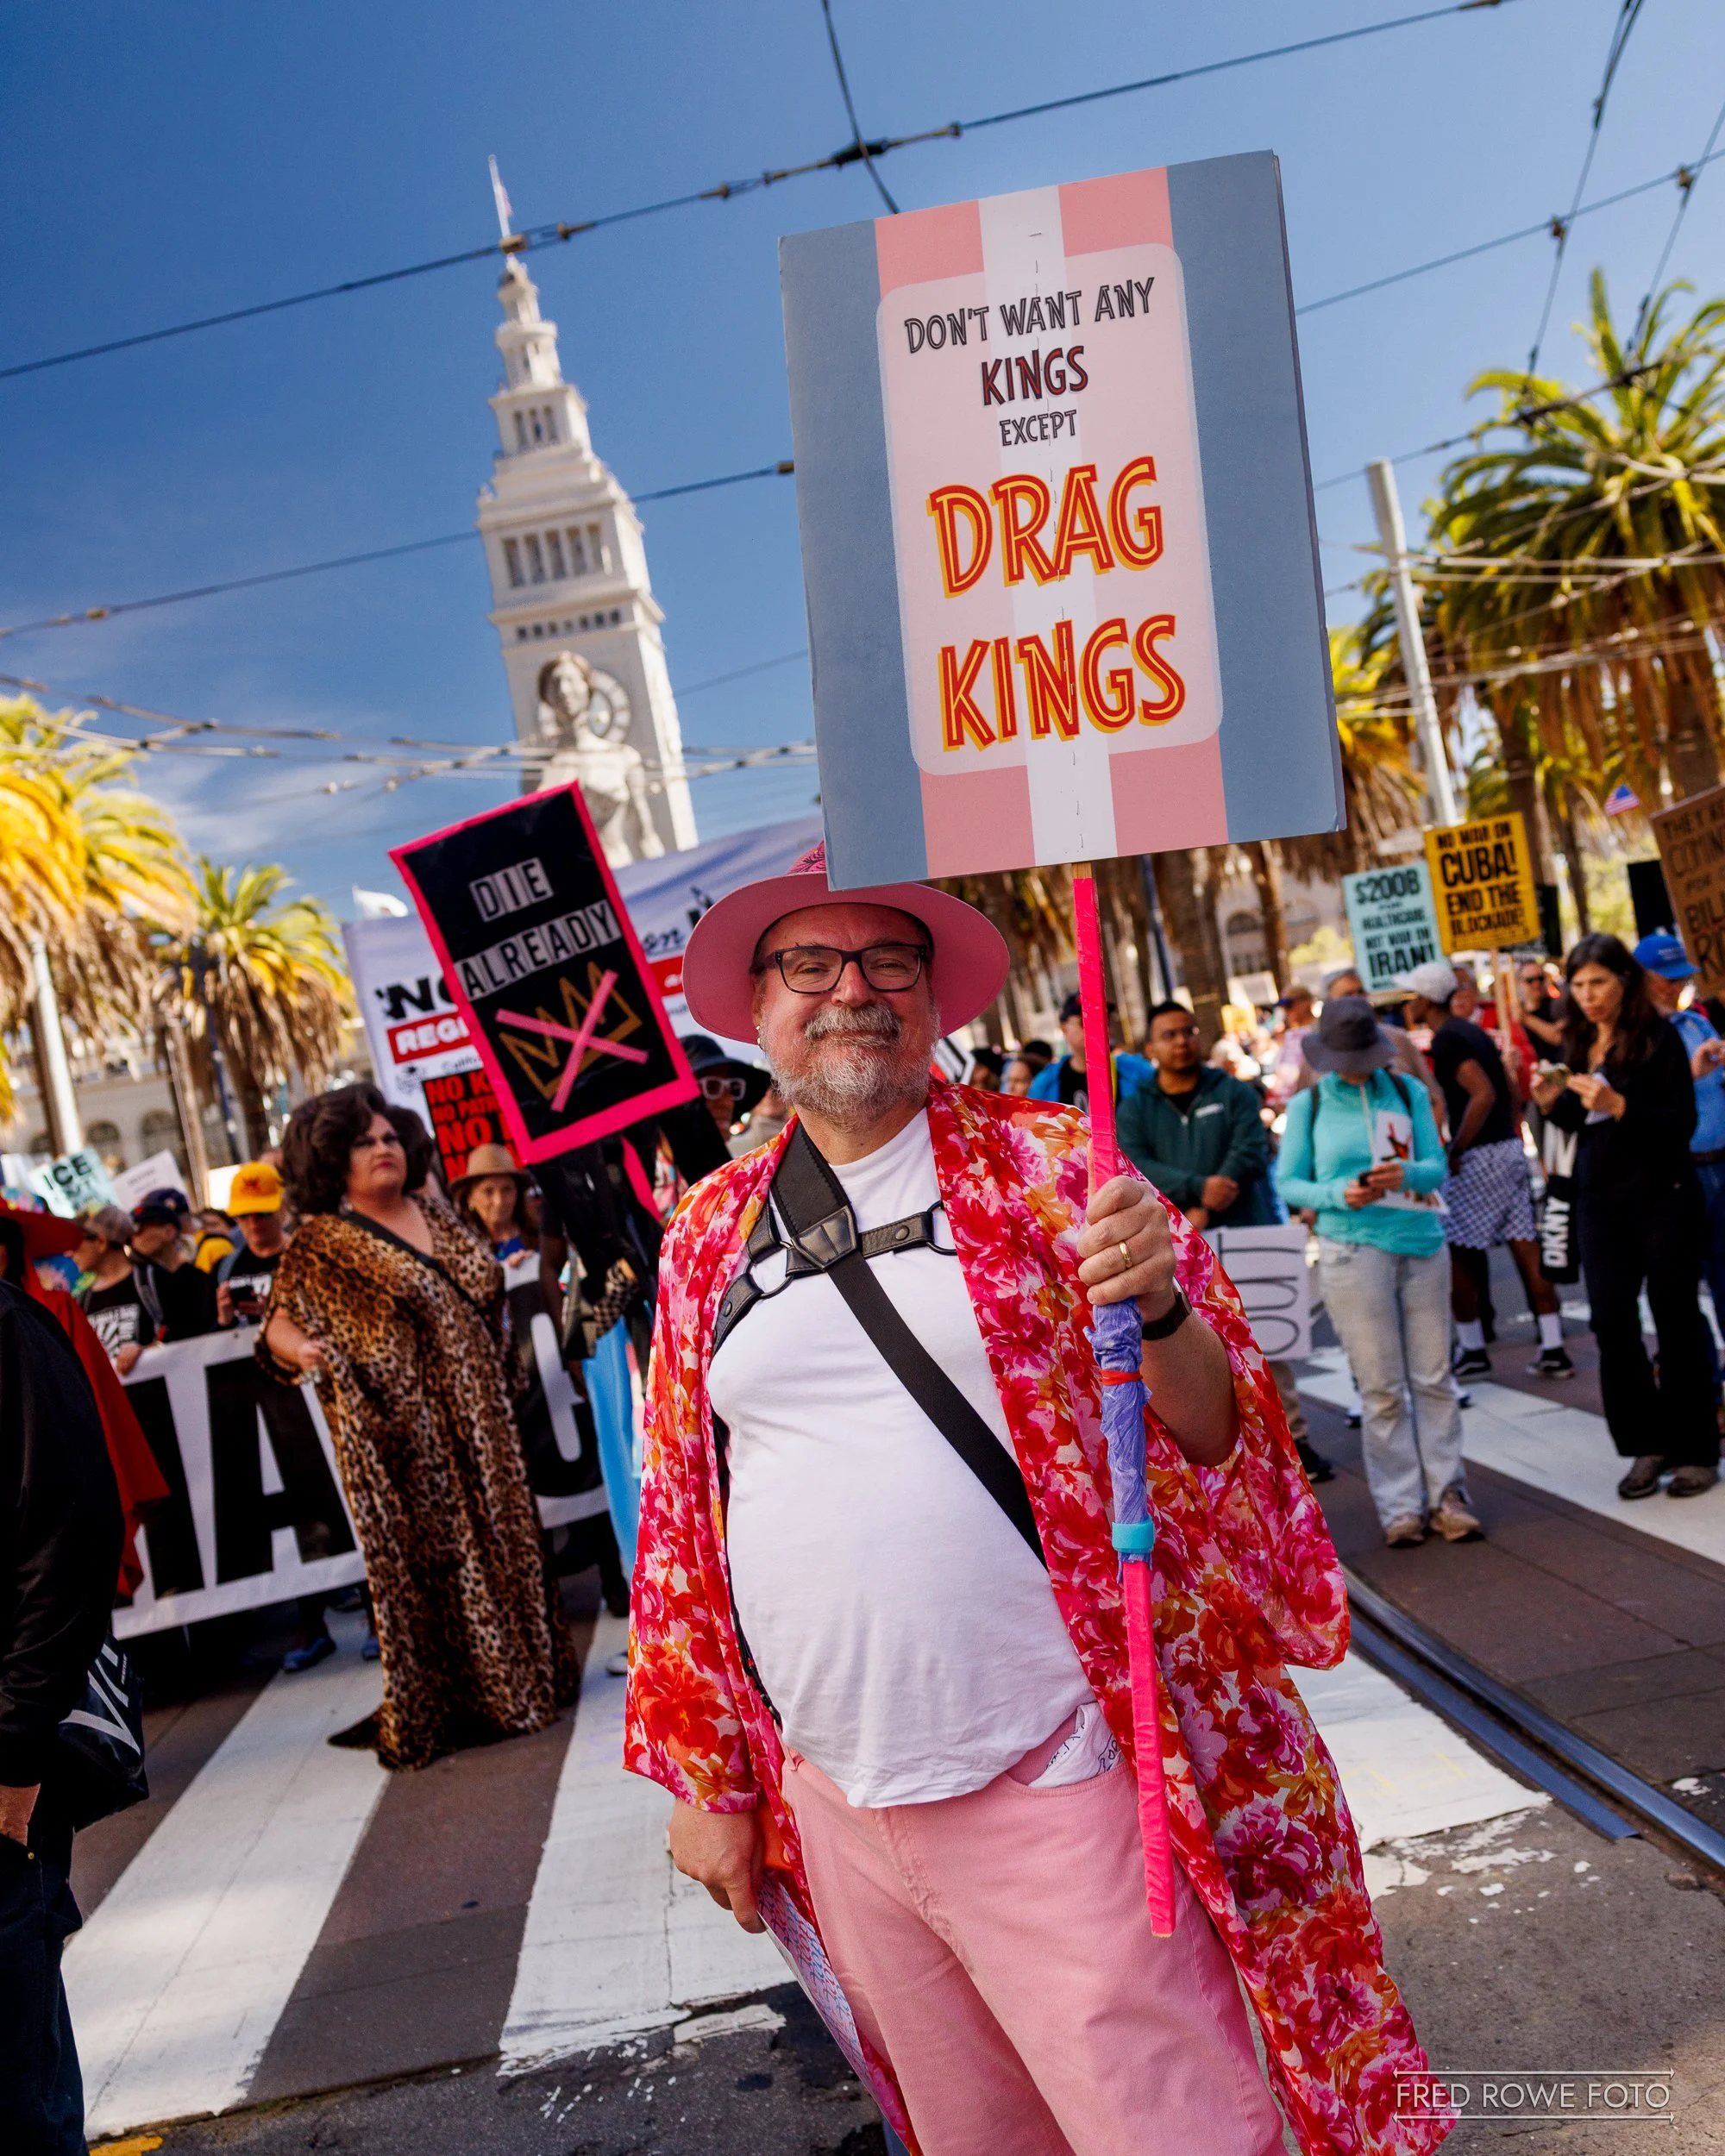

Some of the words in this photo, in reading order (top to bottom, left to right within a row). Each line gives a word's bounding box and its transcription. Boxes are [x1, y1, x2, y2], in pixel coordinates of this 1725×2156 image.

[905, 305, 988, 354] DON'T
[1000, 290, 1082, 338] WANT
[1095, 276, 1154, 323] ANY
[981, 345, 1088, 405] KINGS
[1000, 409, 1077, 447] EXCEPT
[926, 455, 1164, 598] DRAG
[938, 613, 1186, 752] KINGS
[1356, 868, 1420, 904] $200B
[1441, 841, 1518, 887] CUBA!
[475, 862, 546, 918] DIE
[1446, 888, 1484, 915] END
[1487, 881, 1521, 907] THE
[461, 903, 612, 997] ALREADY
[1369, 943, 1435, 977] IRAN!
[436, 1116, 492, 1156] NO
[43, 1155, 92, 1190] ICE
[1541, 1196, 1571, 1269] DKNY
